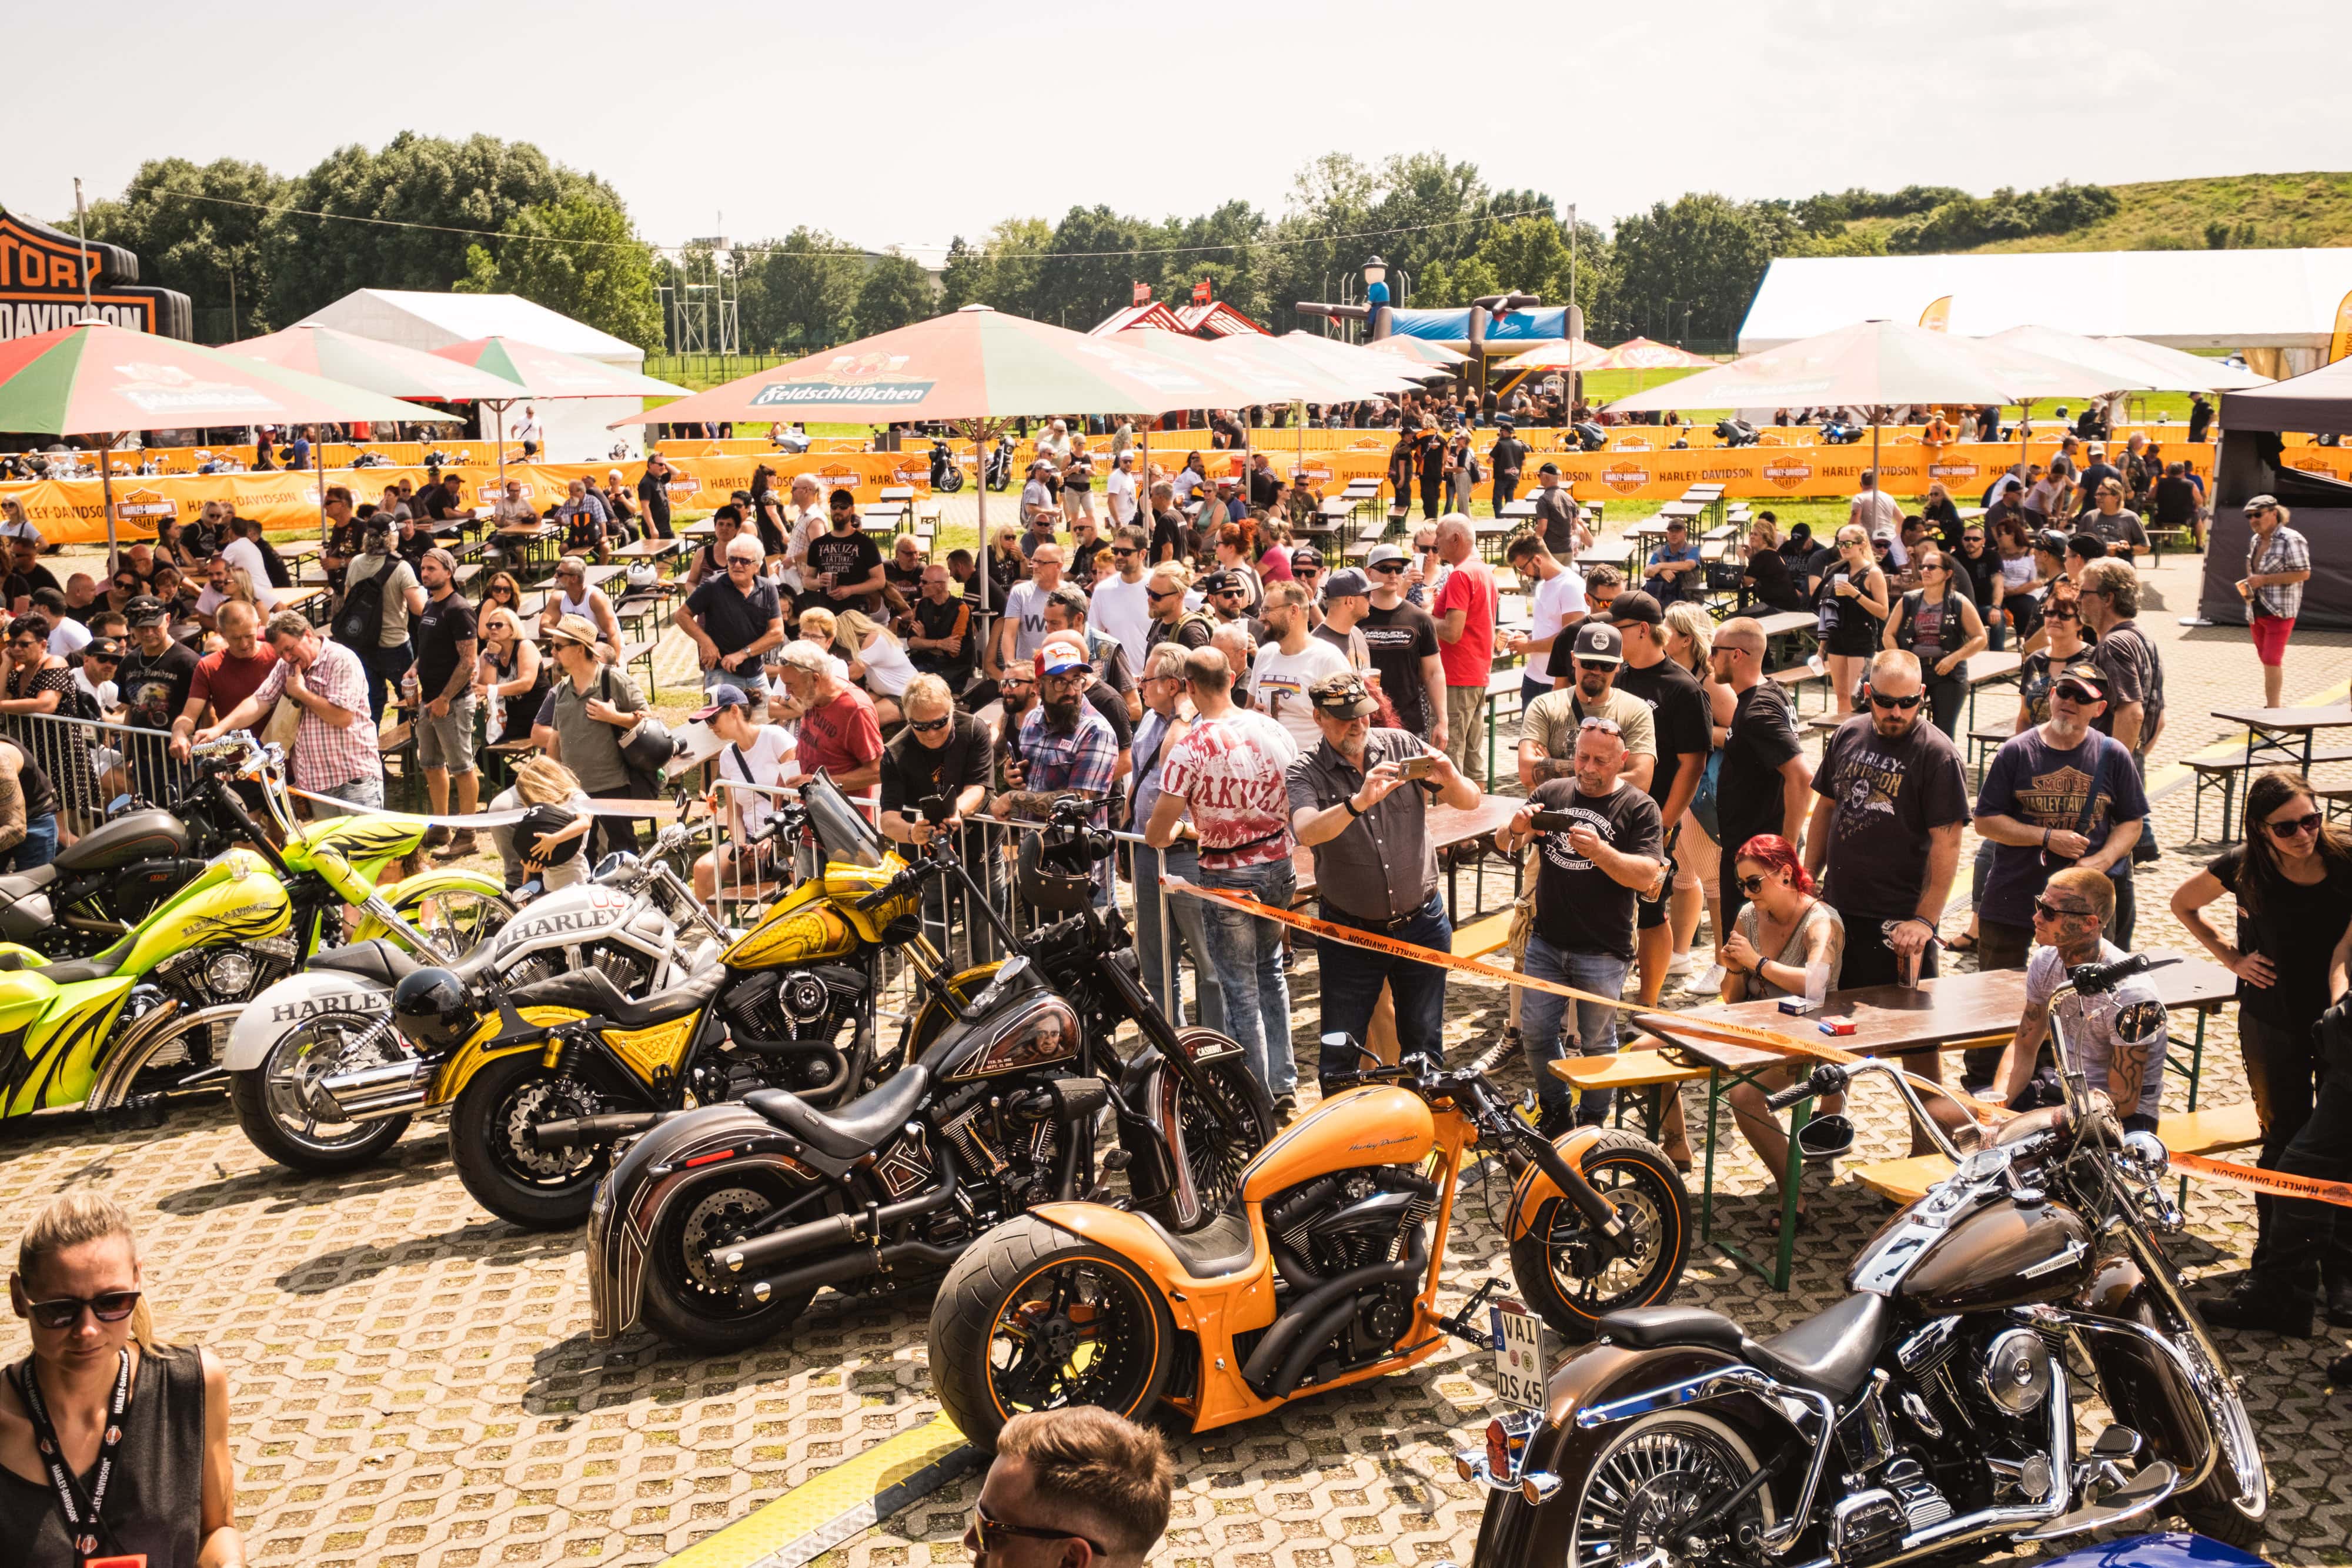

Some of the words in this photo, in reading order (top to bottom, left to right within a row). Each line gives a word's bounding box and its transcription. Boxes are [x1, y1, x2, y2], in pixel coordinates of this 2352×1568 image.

[757, 385, 924, 404] Feldschlößchen
[1659, 468, 1753, 482] HARLEY-DAVIDSON
[819, 544, 859, 557] YAKUZA
[1025, 614, 1047, 632] W
[2043, 775, 2090, 793] MOTOR
[1551, 854, 1589, 868] FUCHSMÜHL
[1503, 1313, 1535, 1346] VAI
[1496, 1335, 1502, 1346] D
[1499, 1372, 1519, 1400] DS
[1523, 1380, 1543, 1407] 45
